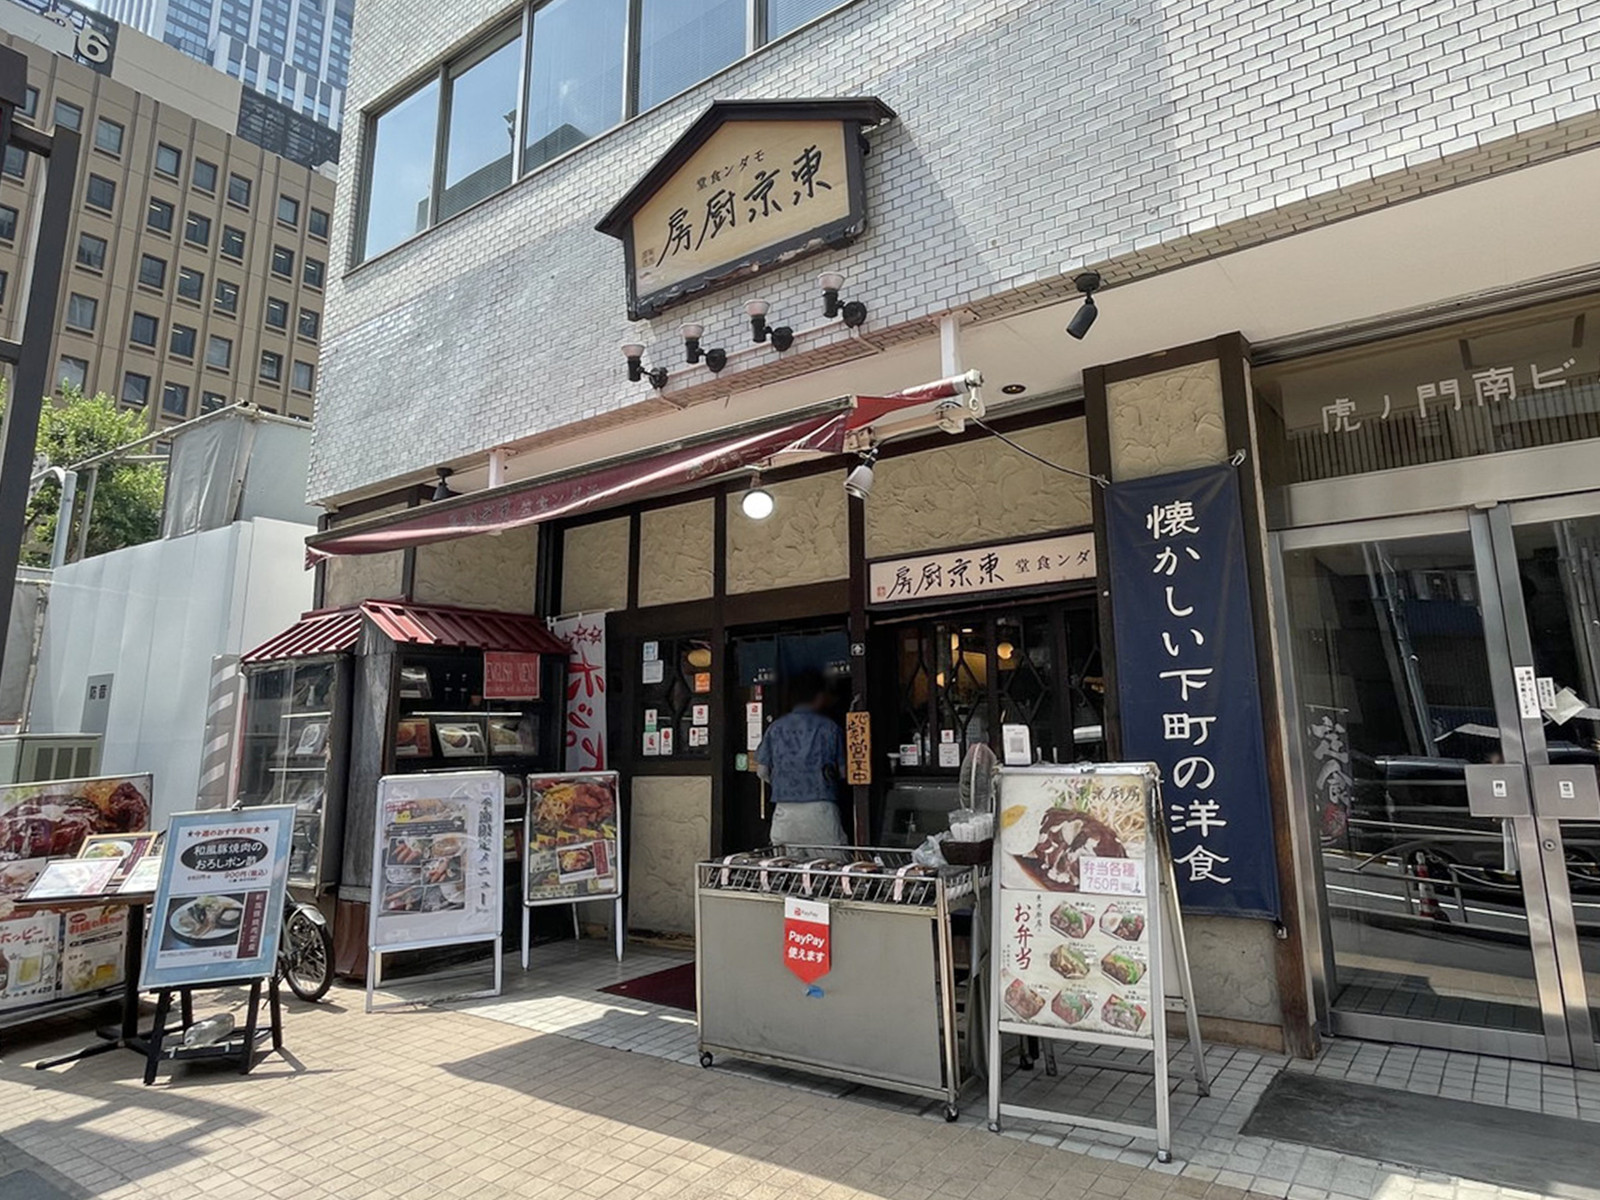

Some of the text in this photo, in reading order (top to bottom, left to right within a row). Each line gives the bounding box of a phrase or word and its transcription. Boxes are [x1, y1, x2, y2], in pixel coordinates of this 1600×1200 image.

[1321, 358, 1600, 433] 虎ノ門南ビ
[1146, 500, 1231, 884] 懐かしい下町の洋食
[1083, 861, 1136, 878] 弁当各種
[1087, 877, 1119, 891] 750円
[788, 930, 825, 948] PayPay
[1013, 902, 1034, 971] お弁当
[788, 946, 825, 963] 使えます
